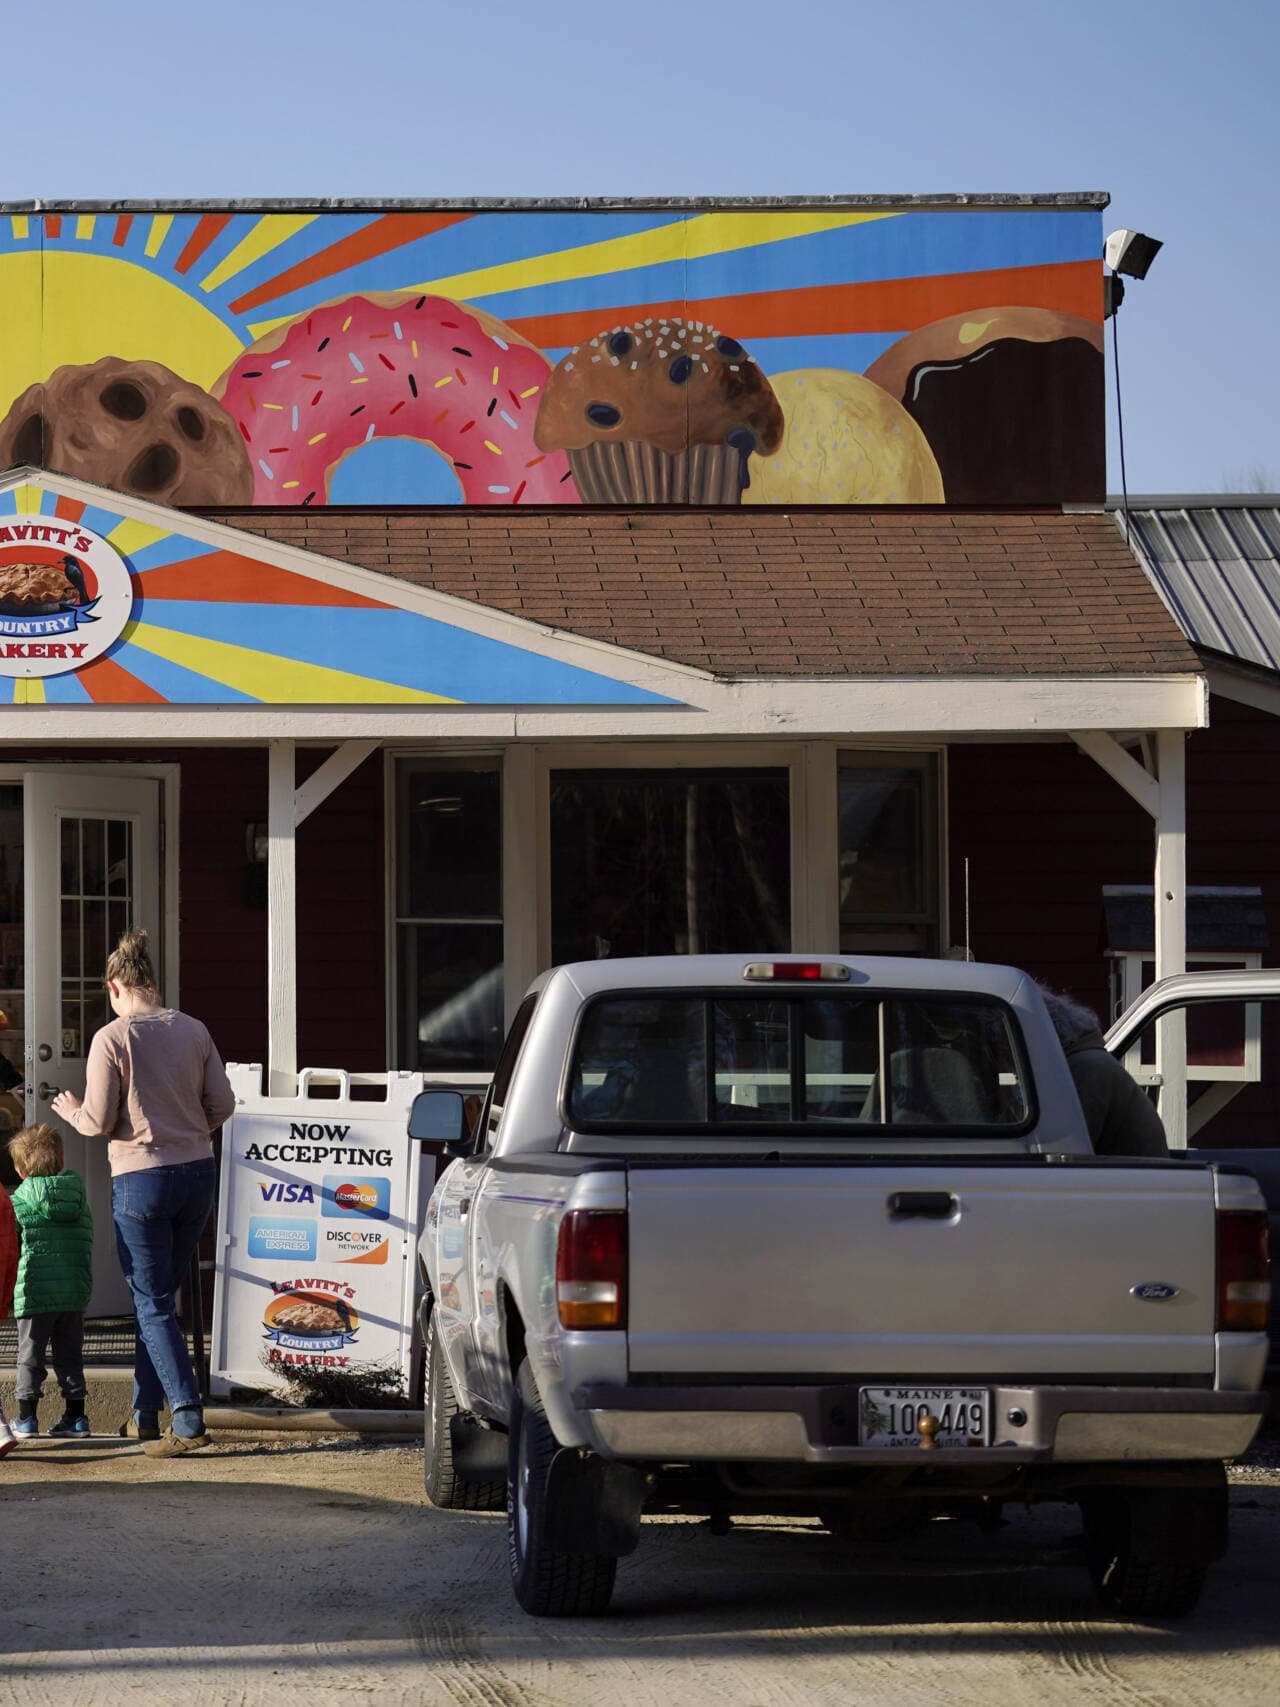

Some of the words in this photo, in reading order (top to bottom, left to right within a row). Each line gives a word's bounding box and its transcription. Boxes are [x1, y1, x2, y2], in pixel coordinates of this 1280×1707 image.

[289, 1123, 350, 1142] NOW
[245, 1143, 393, 1166] ACCEPTING
[257, 1183, 314, 1203] VISA
[335, 1192, 378, 1202] MasterCard
[256, 1229, 305, 1240] AMERICAN
[327, 1232, 381, 1243] DISCOVER
[267, 1240, 309, 1250] EXPRESS
[338, 1243, 370, 1251] NETWORK
[270, 1278, 356, 1300] LEAVITT'S
[1142, 1286, 1167, 1297] Ford
[279, 1335, 340, 1349] COUNTRY
[269, 1348, 350, 1367] BAKERY
[896, 1390, 953, 1400] MAINE
[940, 1403, 984, 1436] 449
